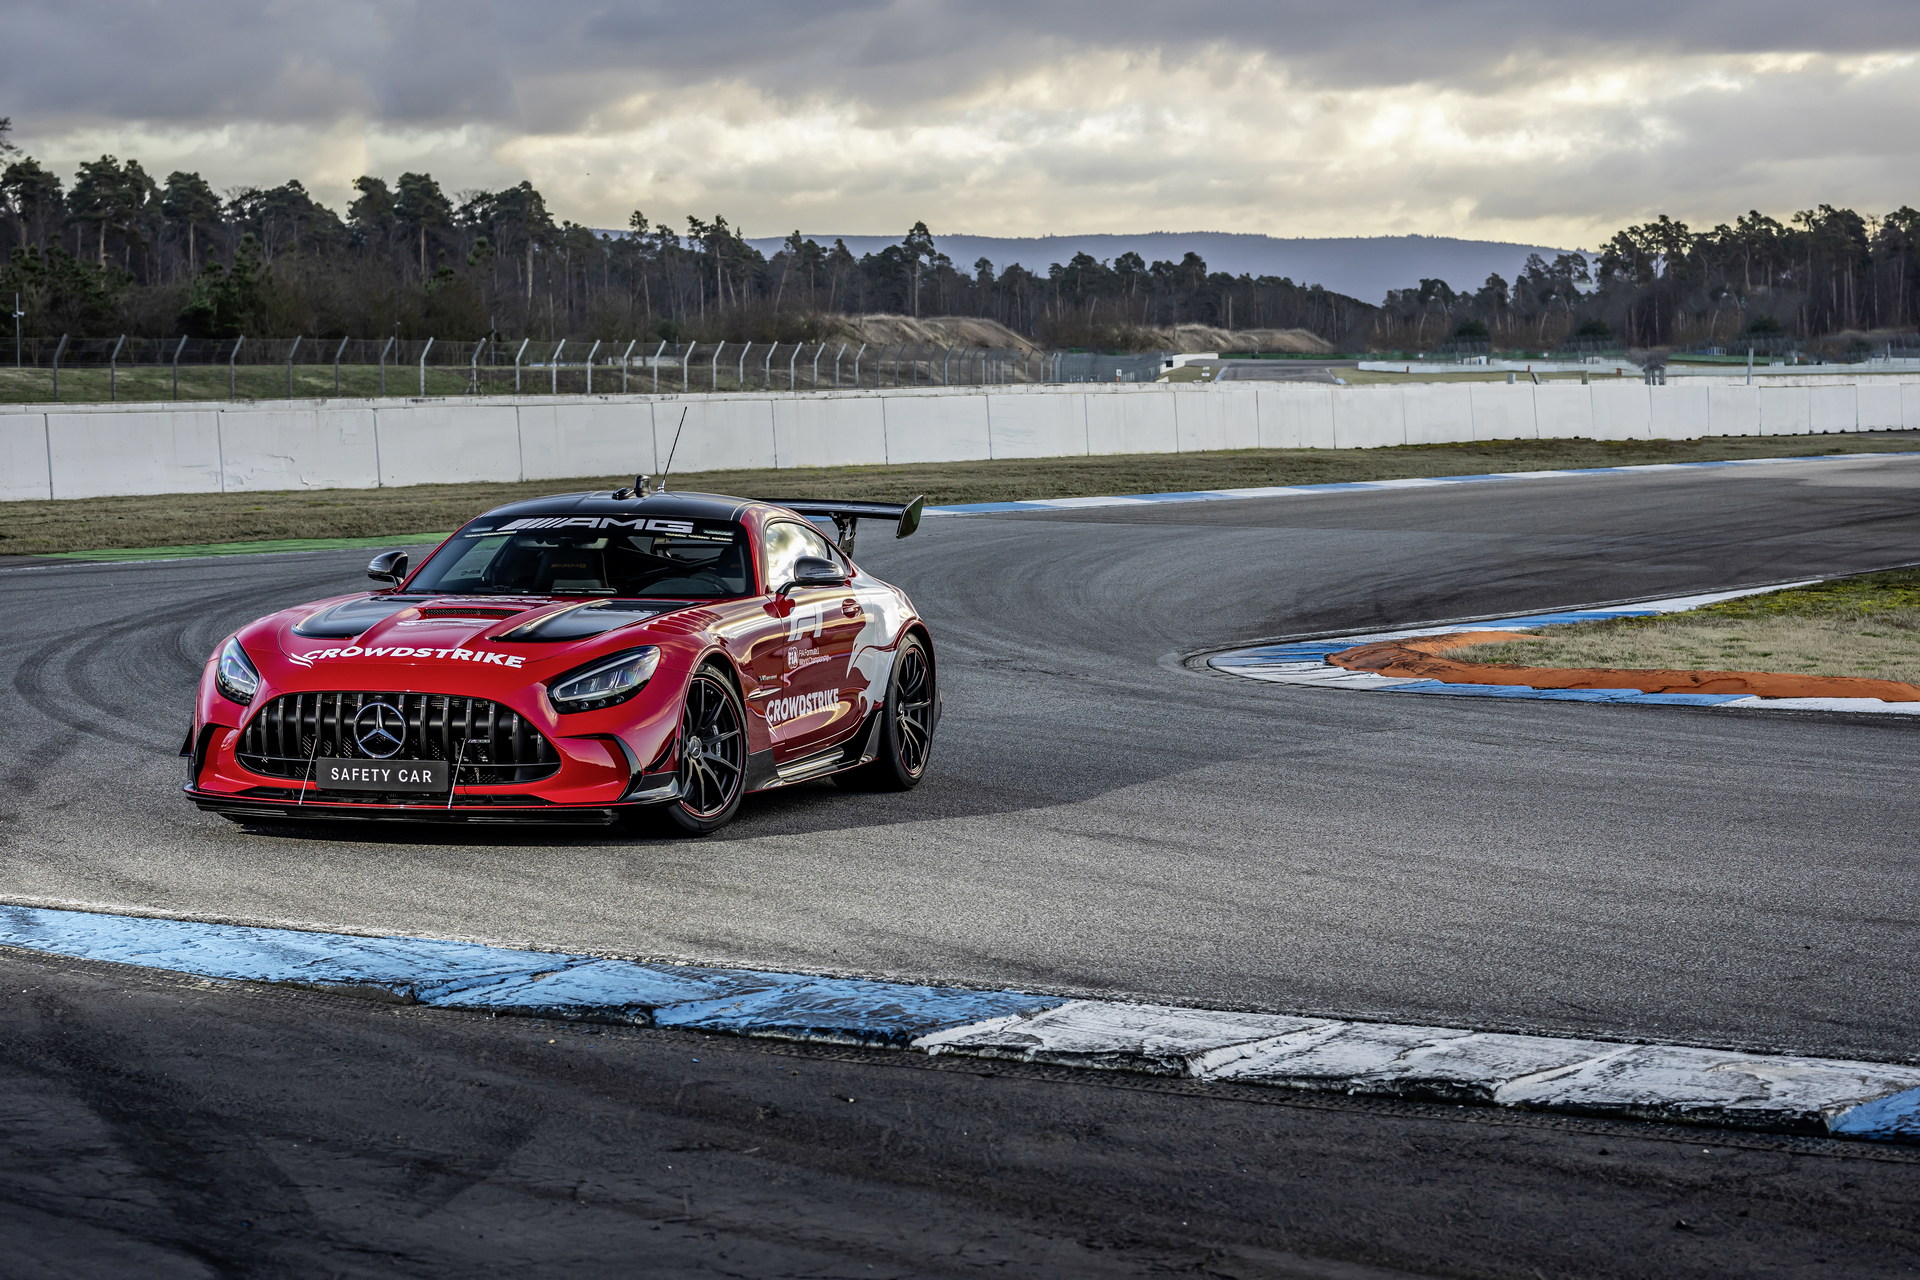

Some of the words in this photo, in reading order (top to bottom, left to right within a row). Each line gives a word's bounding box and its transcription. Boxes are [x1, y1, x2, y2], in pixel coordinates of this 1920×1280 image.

[301, 645, 527, 669] CROWDSTRIKE
[766, 688, 841, 722] CROWDSTRIKE
[331, 767, 391, 782] SAFETY
[398, 769, 432, 783] CAR
